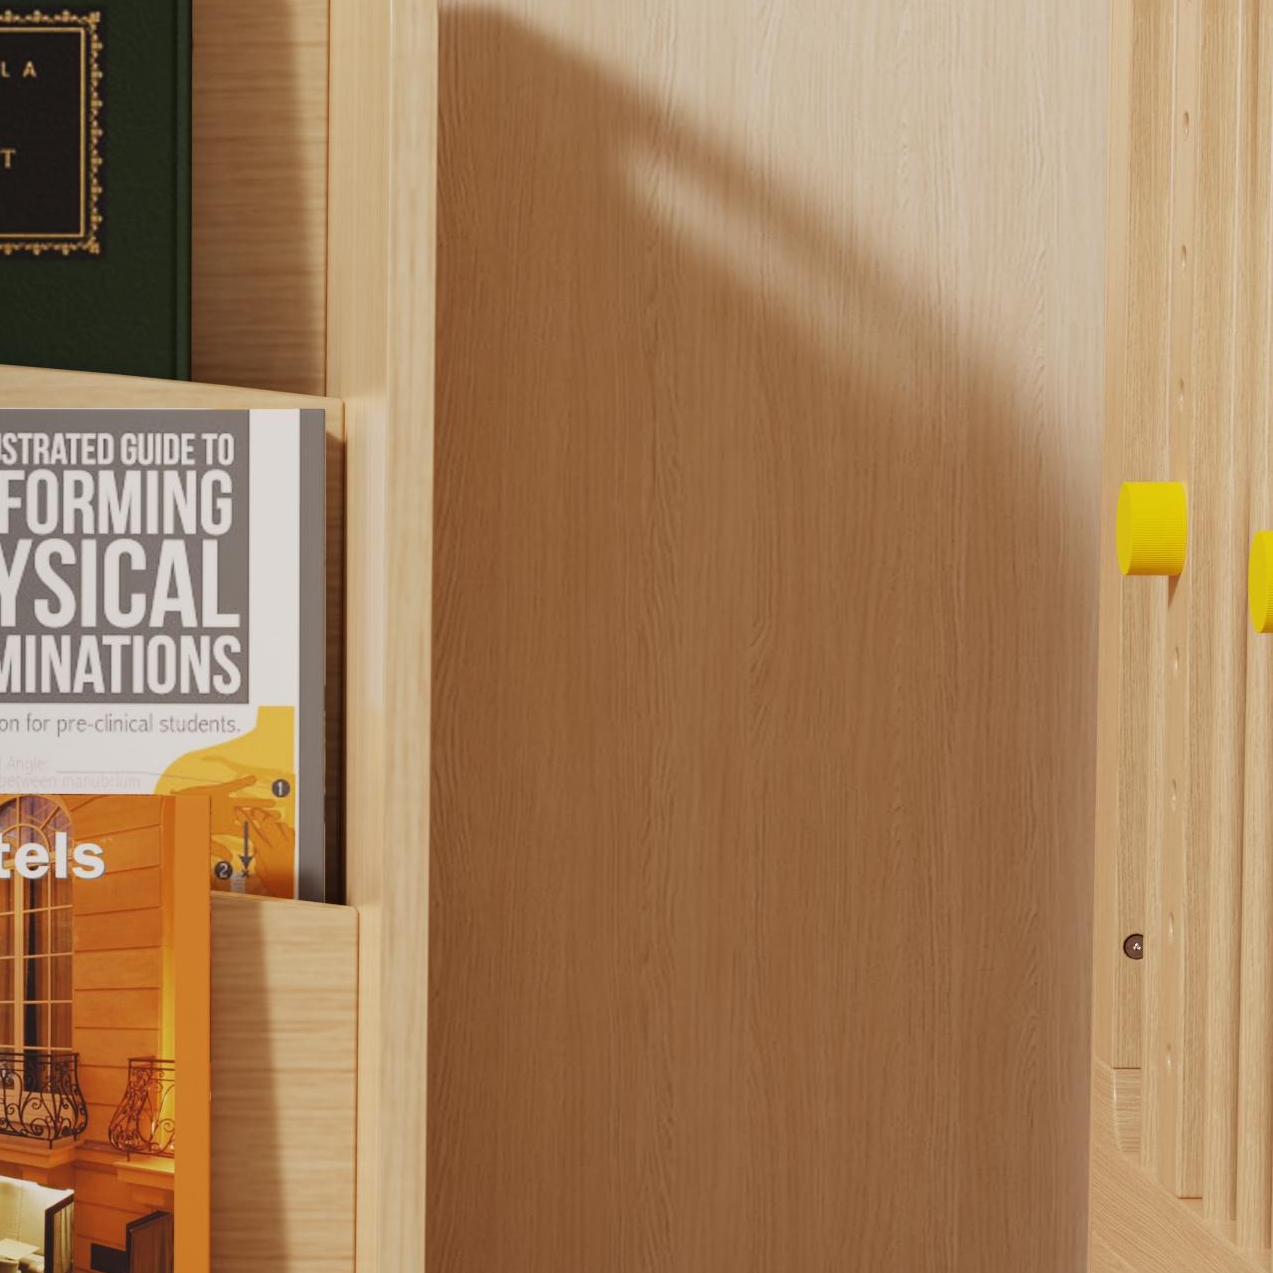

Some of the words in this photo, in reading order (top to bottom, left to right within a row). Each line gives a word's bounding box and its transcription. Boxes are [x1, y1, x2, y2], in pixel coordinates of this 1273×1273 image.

[120, 431, 196, 465] GUIDE
[201, 431, 236, 465] TO
[26, 713, 51, 733] for
[56, 713, 154, 738] pre-clinical
[159, 713, 242, 734] students.
